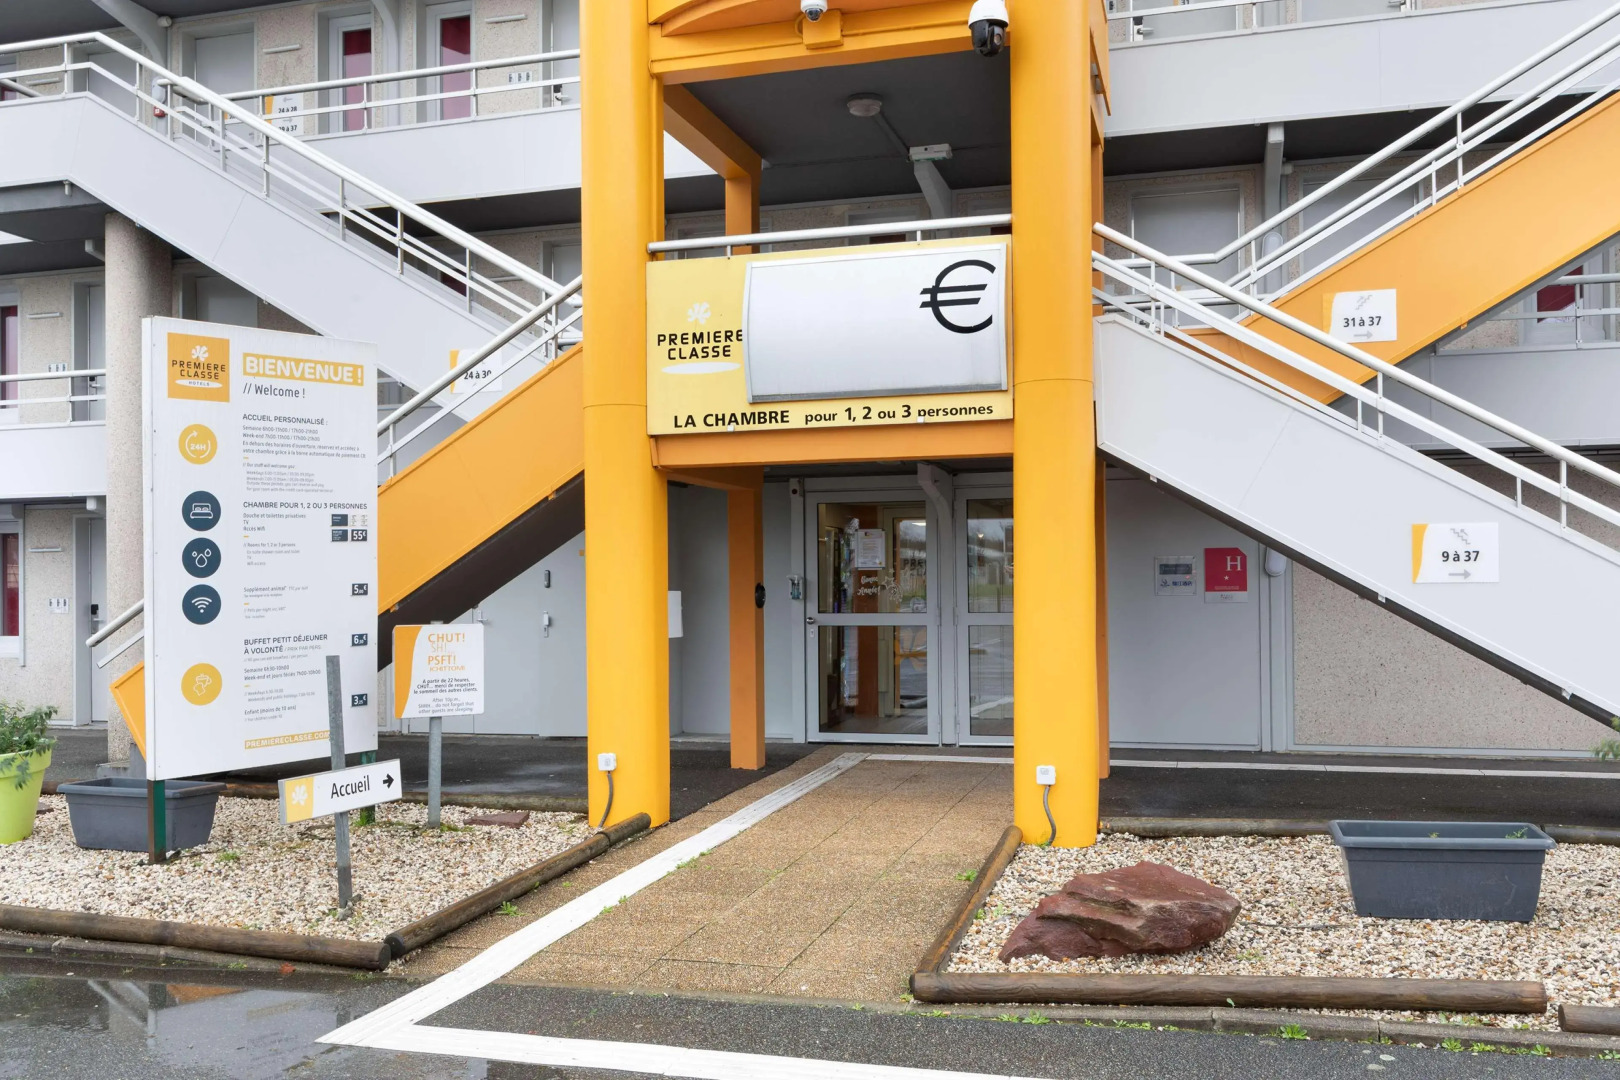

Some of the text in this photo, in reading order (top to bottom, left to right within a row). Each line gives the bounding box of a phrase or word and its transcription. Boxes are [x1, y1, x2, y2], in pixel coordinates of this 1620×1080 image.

[919, 259, 996, 334] €
[1343, 315, 1382, 328] 31 à 37
[657, 328, 743, 346] PREMIERE
[667, 345, 731, 360] CLASSE
[171, 359, 226, 373] PREMIERE
[245, 356, 353, 383] BIENVENUE
[180, 369, 220, 380] CLASSE
[464, 371, 473, 380] 24
[254, 383, 300, 398] Welcome
[243, 413, 324, 426] ACCUEIL PERSONNALISÉ
[674, 403, 994, 428] LA CHAMBRE pour 1, 2 ou 3 personnes
[1441, 550, 1480, 562] 9 à 37
[1225, 555, 1242, 571] H
[244, 634, 328, 646] BUFFET PETIT DÉJEUNER
[428, 632, 465, 643] CHUT!
[244, 646, 249, 655] À
[250, 645, 284, 654] VOLONTÉ
[427, 655, 456, 665] PSFT!
[331, 774, 370, 799] Accueil
